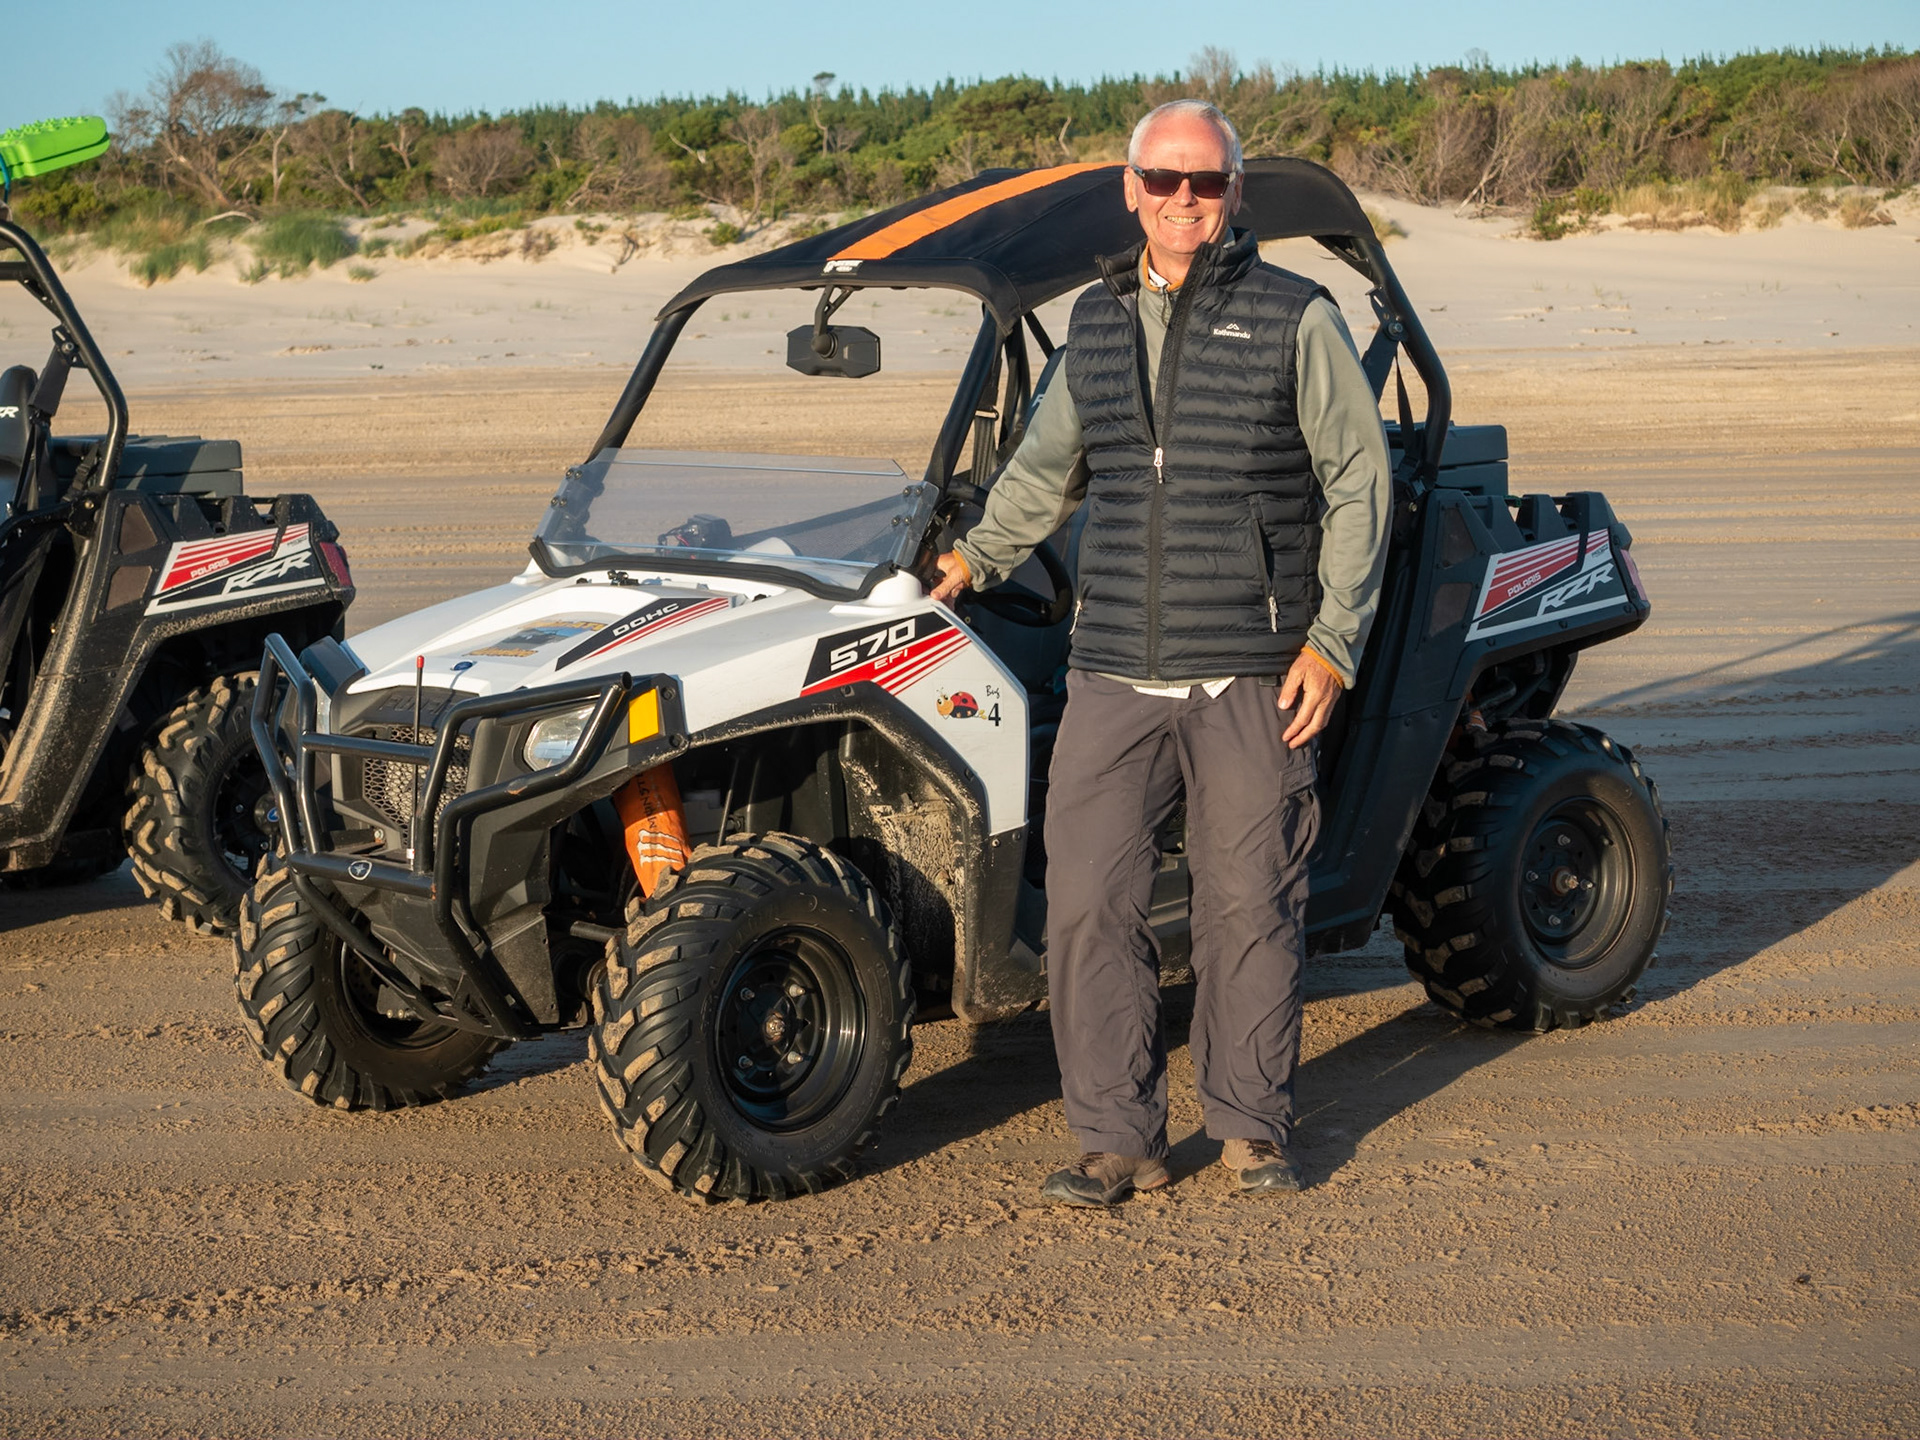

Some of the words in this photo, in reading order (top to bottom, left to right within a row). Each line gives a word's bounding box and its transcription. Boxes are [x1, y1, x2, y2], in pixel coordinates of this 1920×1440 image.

[1213, 328, 1251, 339] Kathmandu
[190, 557, 230, 578] POLARIS
[221, 550, 312, 595] RZR
[1507, 571, 1542, 597] POLARIS
[1537, 562, 1614, 616] RZR
[612, 602, 680, 637] DOHC
[830, 618, 915, 672] 570
[874, 648, 908, 670] EFI
[985, 684, 1000, 700] Bug
[988, 703, 1001, 727] 4
